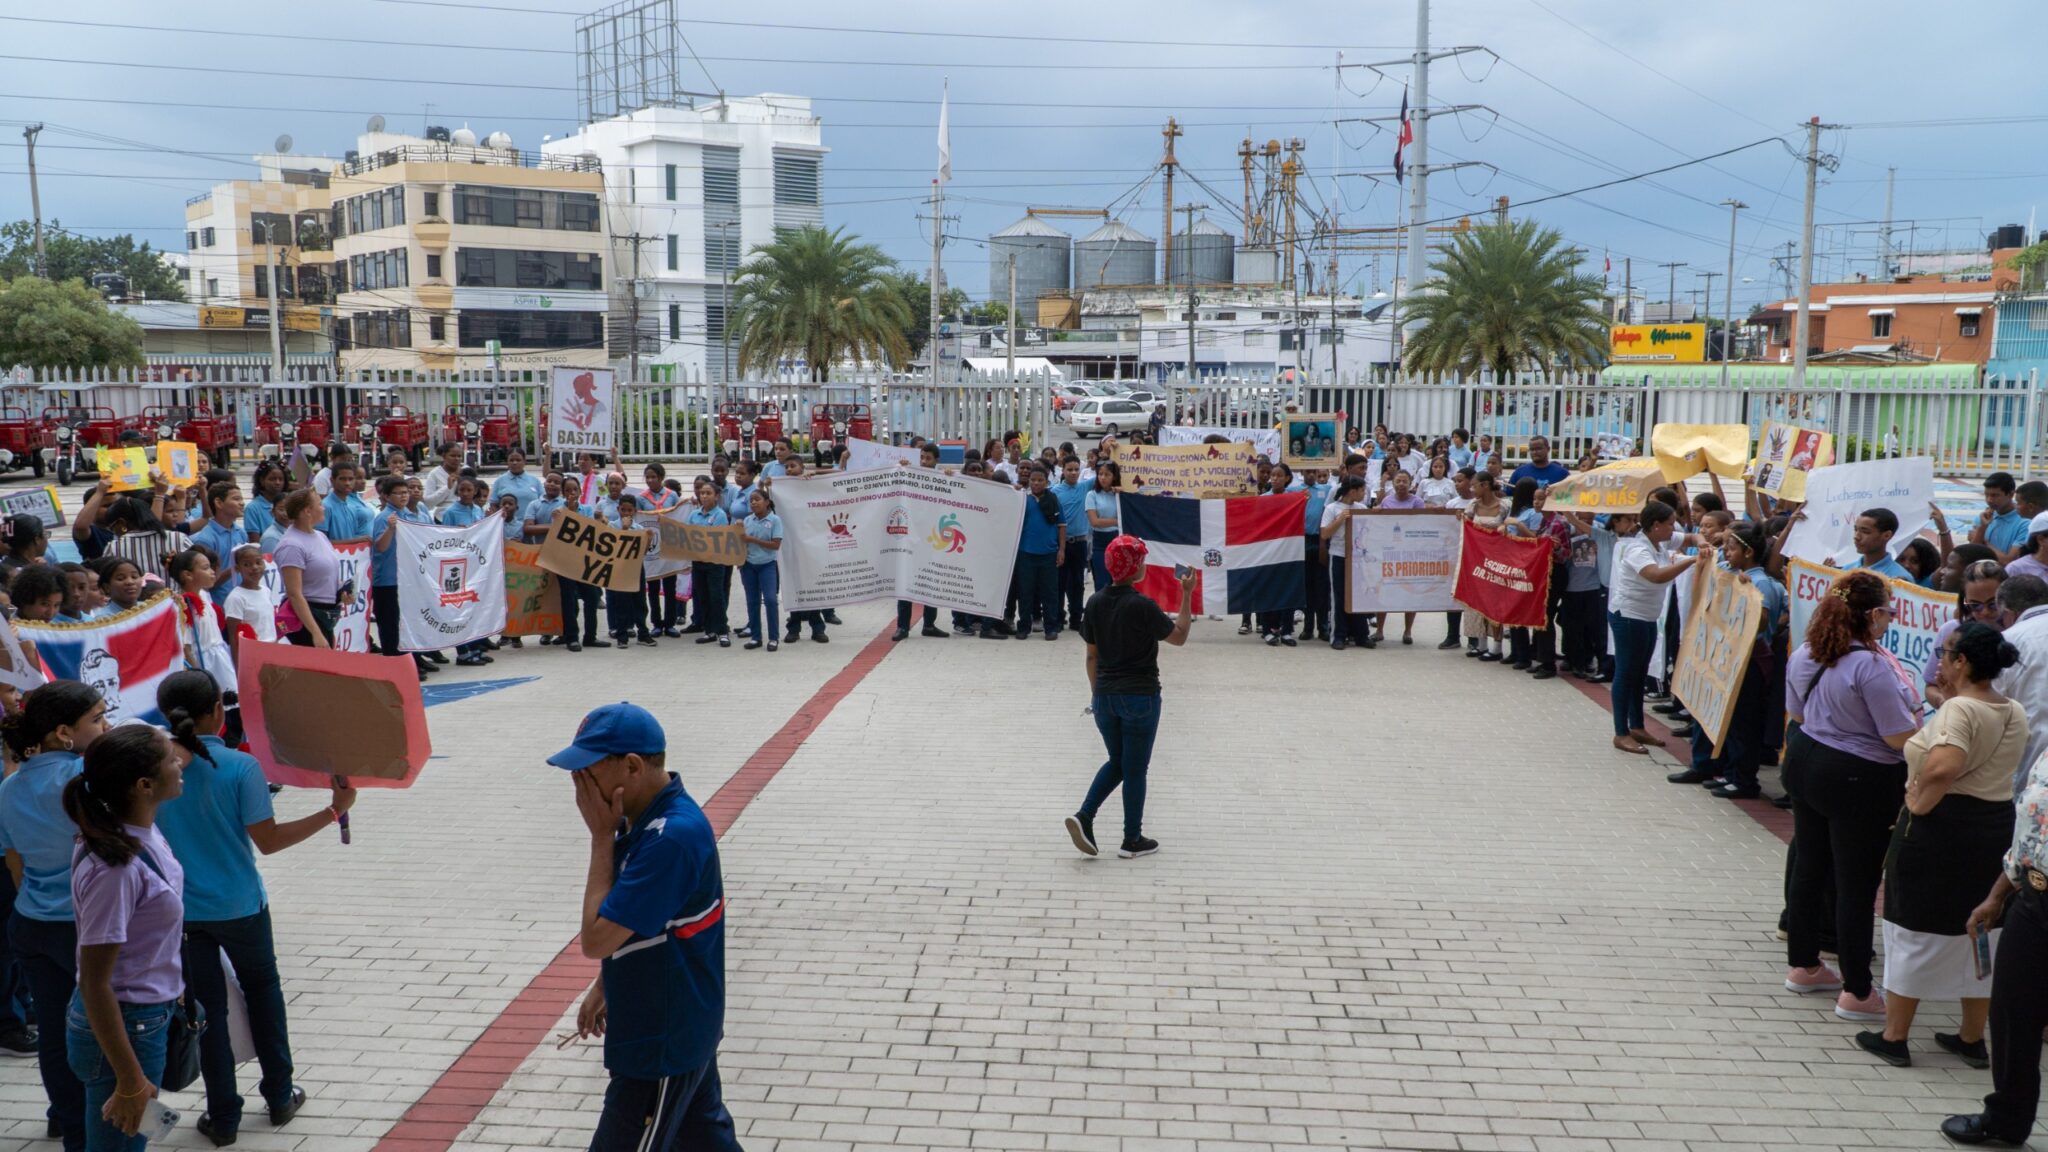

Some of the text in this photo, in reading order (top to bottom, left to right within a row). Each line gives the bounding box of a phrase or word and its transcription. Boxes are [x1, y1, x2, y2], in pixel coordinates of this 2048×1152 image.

[557, 429, 606, 446] BASTA!
[1144, 452, 1212, 463] INTERNACIONAL
[1218, 452, 1229, 460] DE
[1236, 452, 1247, 460] LA
[832, 478, 862, 487] DISTRITO
[862, 472, 899, 482] EDUCATIVO
[1180, 468, 1190, 476] DE
[1194, 466, 1206, 476] LA
[1208, 466, 1250, 476] VIOLENCIA
[872, 481, 890, 489] NIVEL
[934, 486, 952, 494] MINA
[1148, 478, 1184, 488] CONTRA
[1188, 479, 1200, 488] LA
[1826, 482, 1910, 502] Luchemos Contra
[808, 498, 854, 508] TRABAJANDO
[860, 491, 900, 502] INNOVANDO
[938, 500, 989, 513] PROGRESANDO
[1579, 490, 1600, 506] NO
[1606, 486, 1638, 506] MÁS
[1832, 512, 1840, 528] la
[556, 516, 642, 560] BASTA
[660, 519, 743, 556] BASTA
[419, 541, 442, 574] CNRO
[581, 555, 614, 588] YÁ
[822, 570, 844, 578] ESCUELA
[852, 566, 874, 574] MENDOZA
[948, 565, 966, 573] NUEVO
[1382, 561, 1449, 577] ES PRIORIDAD
[420, 608, 440, 628] Juan
[1922, 602, 1940, 632] DE
[1905, 633, 1933, 663] LOS
